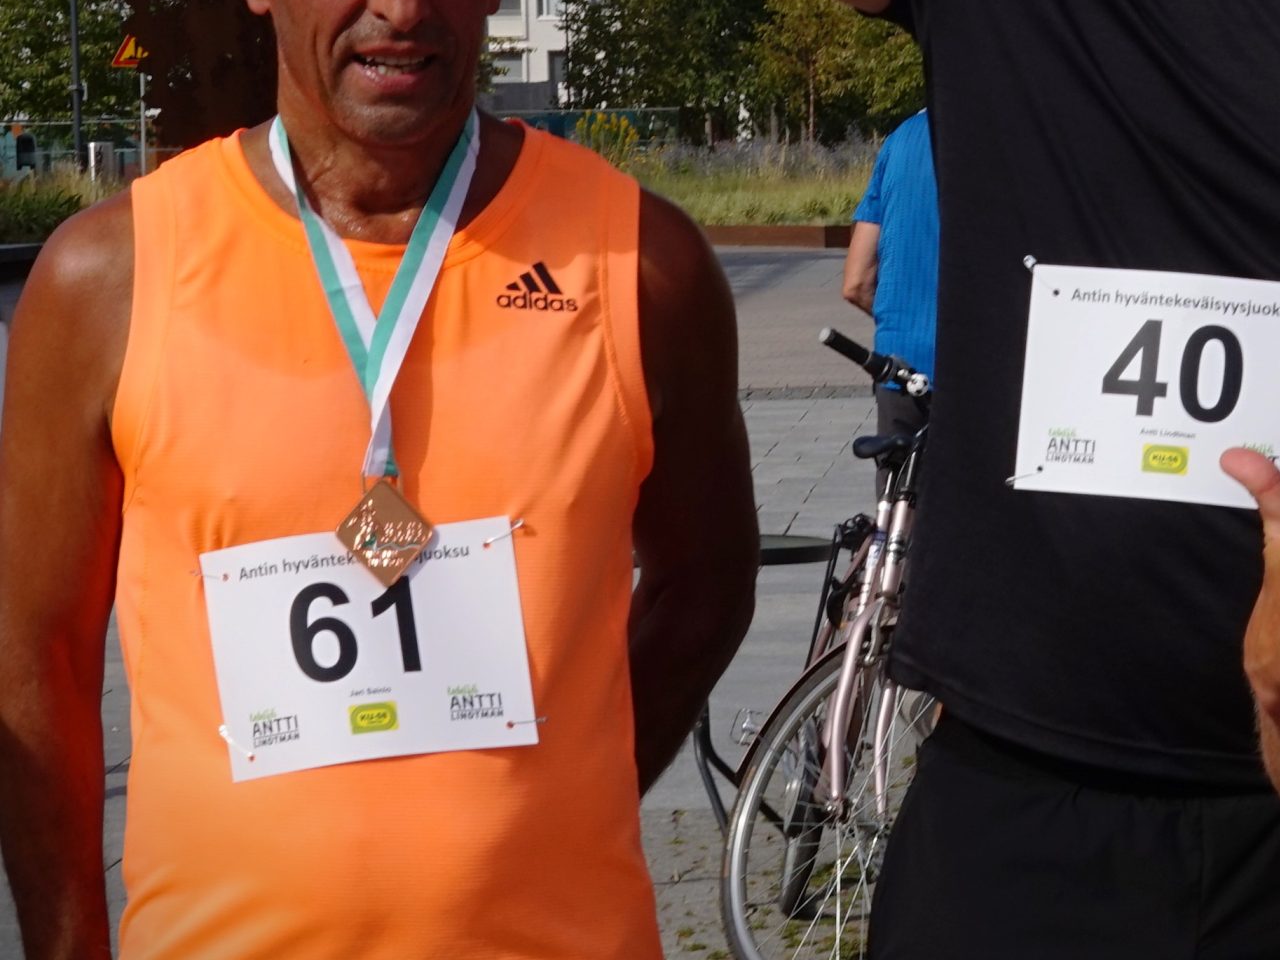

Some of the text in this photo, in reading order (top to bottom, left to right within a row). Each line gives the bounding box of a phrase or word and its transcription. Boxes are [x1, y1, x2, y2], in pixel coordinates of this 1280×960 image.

[496, 291, 578, 312] adidas
[1071, 288, 1110, 304] Antin
[1101, 319, 1243, 423] 40
[1047, 437, 1096, 454] ANTTI
[239, 562, 278, 581] Antin
[290, 574, 423, 683] 61
[450, 693, 503, 710] ANTTI
[253, 715, 299, 738] ANTTI
